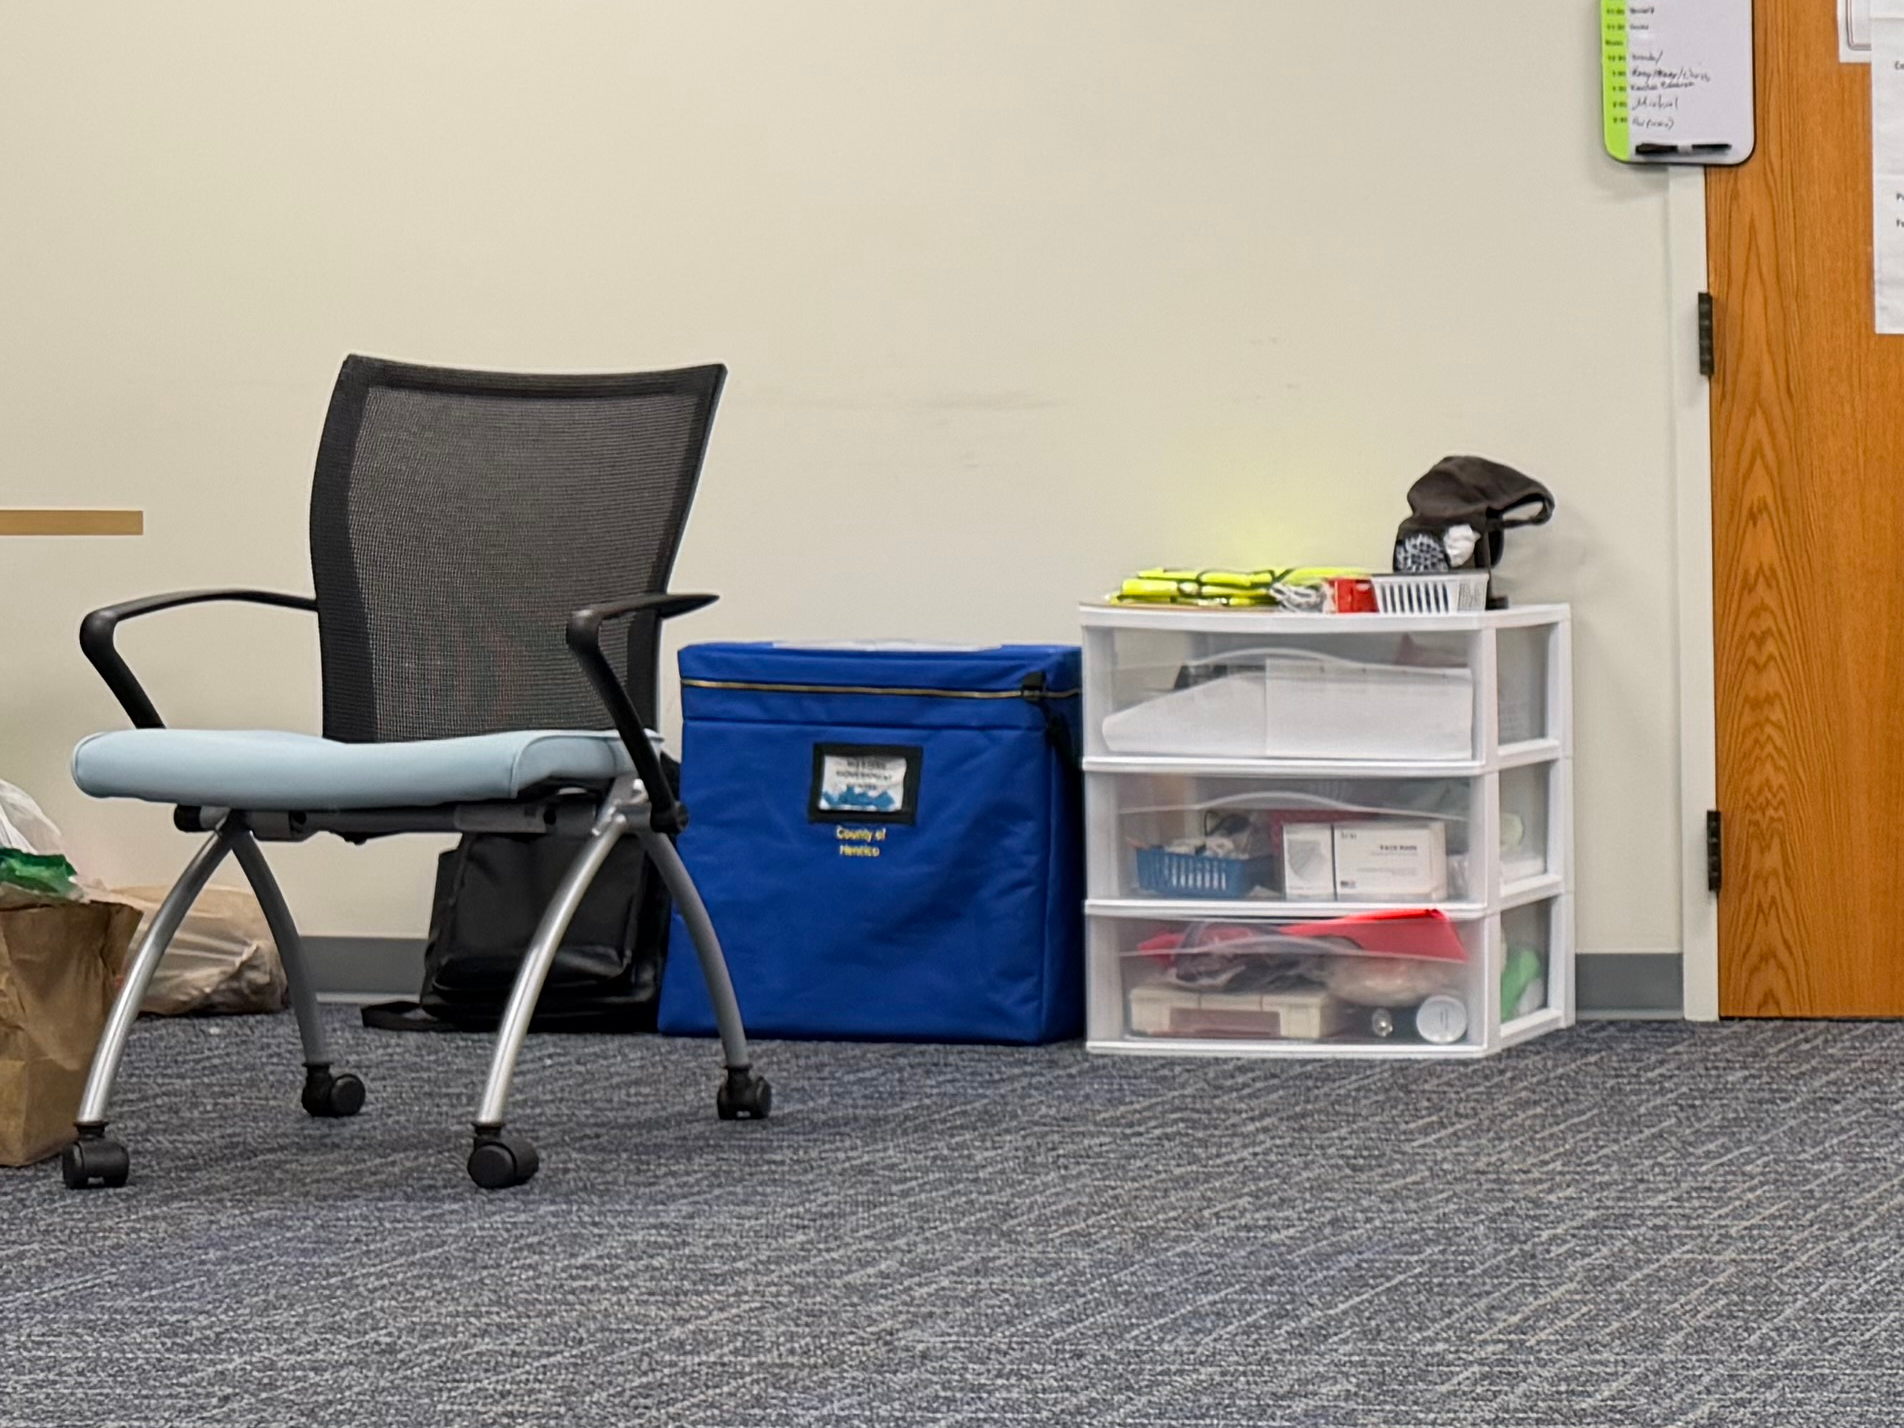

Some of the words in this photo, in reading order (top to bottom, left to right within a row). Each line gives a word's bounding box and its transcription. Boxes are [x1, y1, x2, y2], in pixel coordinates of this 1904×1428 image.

[836, 825, 872, 842] County
[875, 827, 886, 839] of
[840, 845, 880, 857] Henrico
